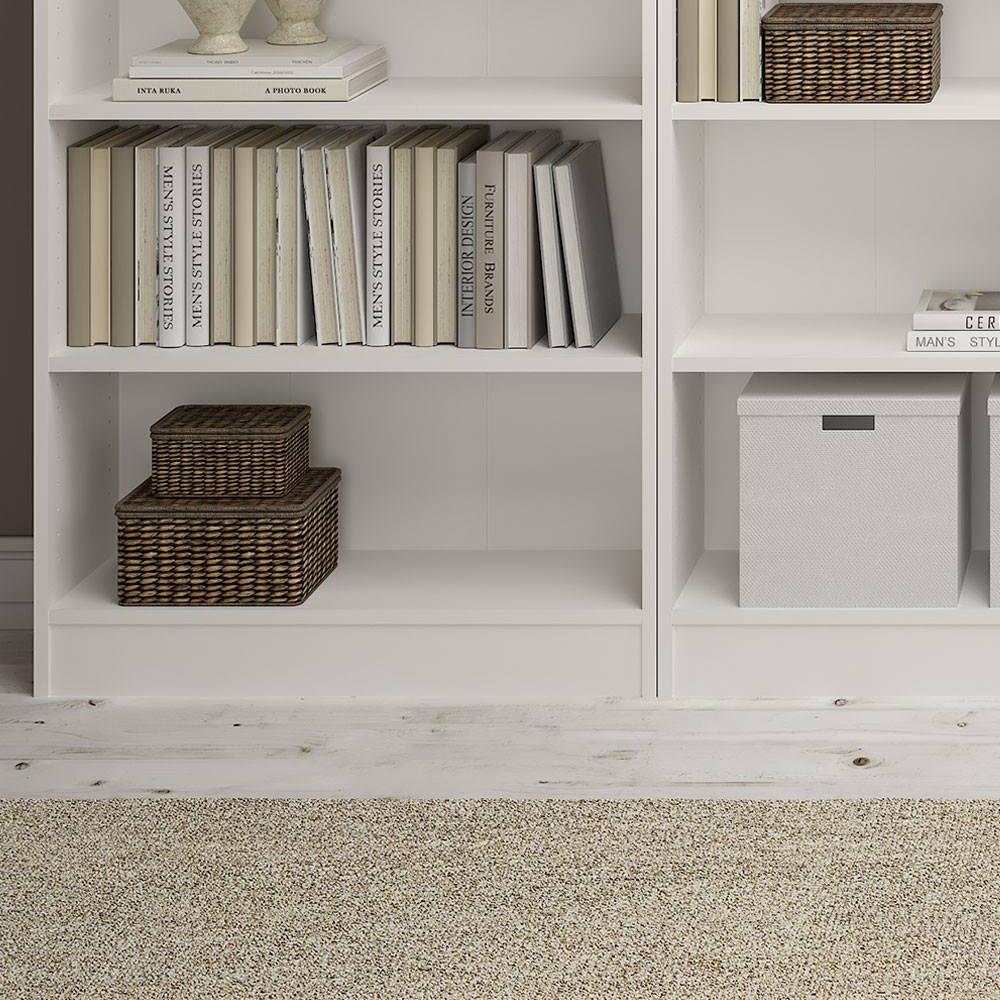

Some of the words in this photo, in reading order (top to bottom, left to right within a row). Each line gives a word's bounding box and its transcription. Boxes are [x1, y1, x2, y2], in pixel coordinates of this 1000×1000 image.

[137, 87, 157, 95] INTA
[159, 87, 181, 95] RUKA
[264, 87, 271, 95] A
[272, 87, 301, 95] PHOTO
[303, 87, 327, 95] BOOK
[162, 165, 174, 212] MEN'S
[191, 163, 203, 228] STORIES
[372, 163, 384, 228] STORIES
[162, 215, 174, 263] STYLE
[460, 195, 474, 247] DESIGN
[484, 184, 496, 255] FURNITURE
[191, 230, 203, 279] STYLE
[372, 230, 383, 279] STYLE
[162, 266, 174, 331] STORIES
[191, 281, 203, 328] MEN'S
[372, 281, 383, 328] MEN'S
[460, 250, 474, 317] INTERIOR
[483, 262, 496, 314] BRANDS
